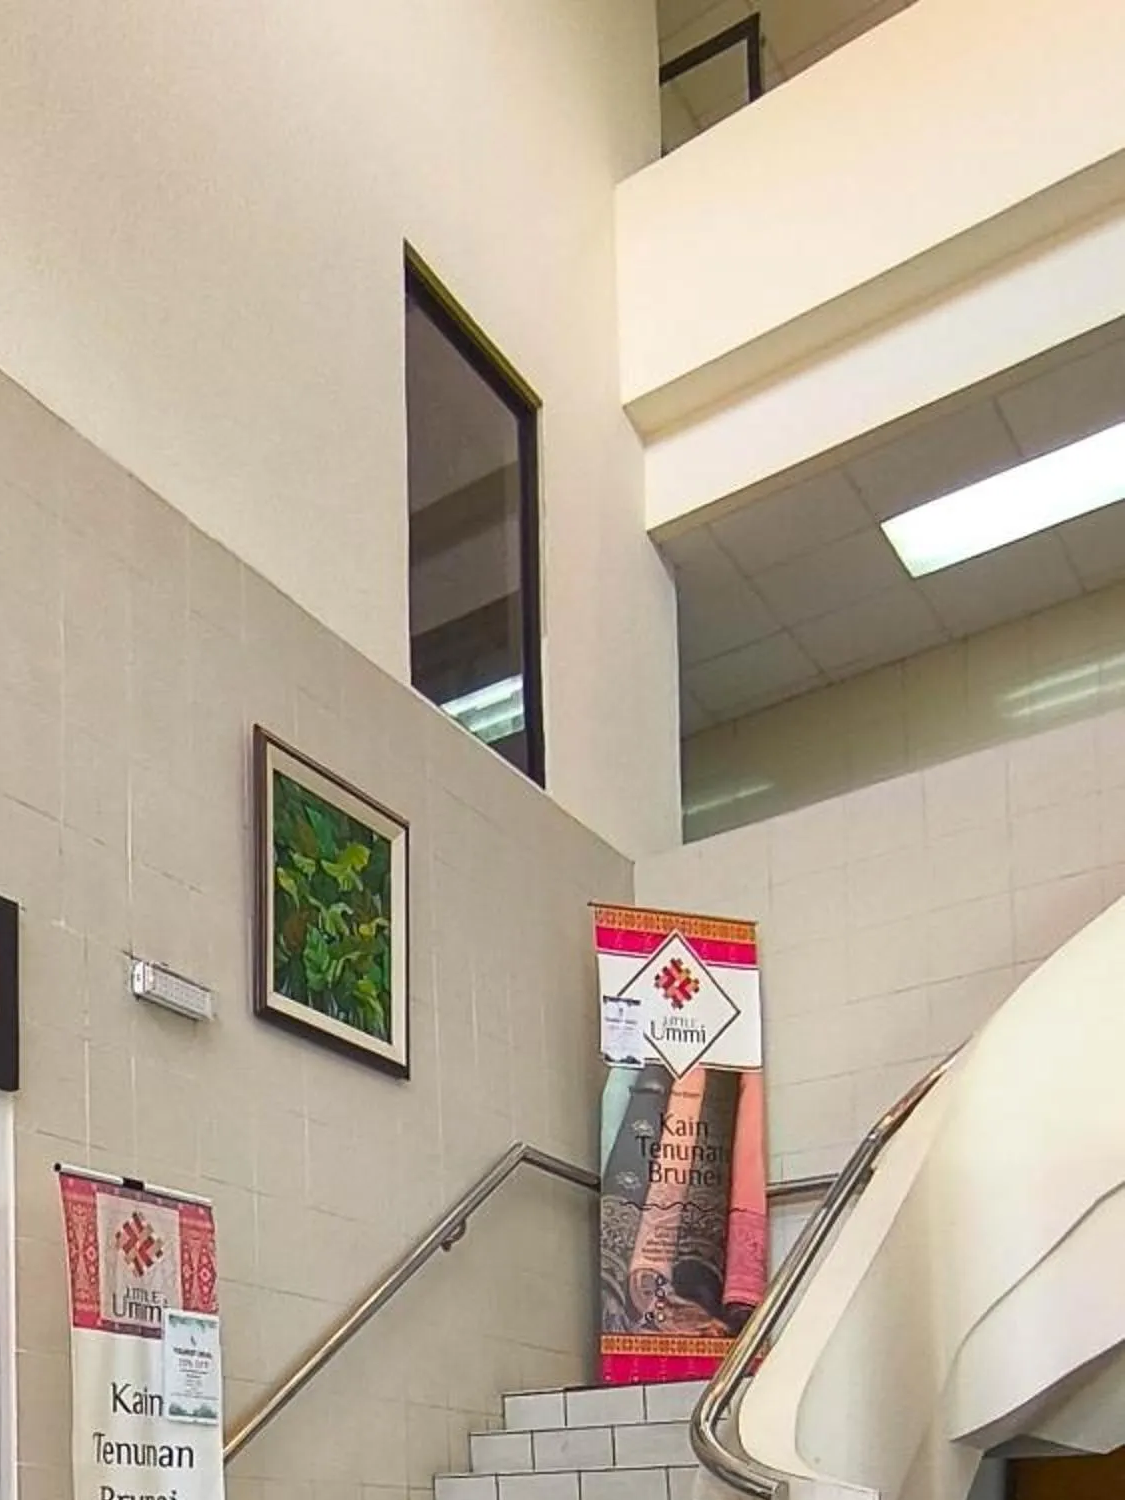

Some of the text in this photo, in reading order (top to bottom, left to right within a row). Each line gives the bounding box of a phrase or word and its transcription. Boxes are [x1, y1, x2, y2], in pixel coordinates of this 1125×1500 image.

[650, 1020, 707, 1044] Ummi
[659, 1111, 709, 1137] Kain
[112, 1292, 163, 1322] Umm
[111, 1381, 164, 1417] Kain
[92, 1431, 194, 1468] Tenunan
